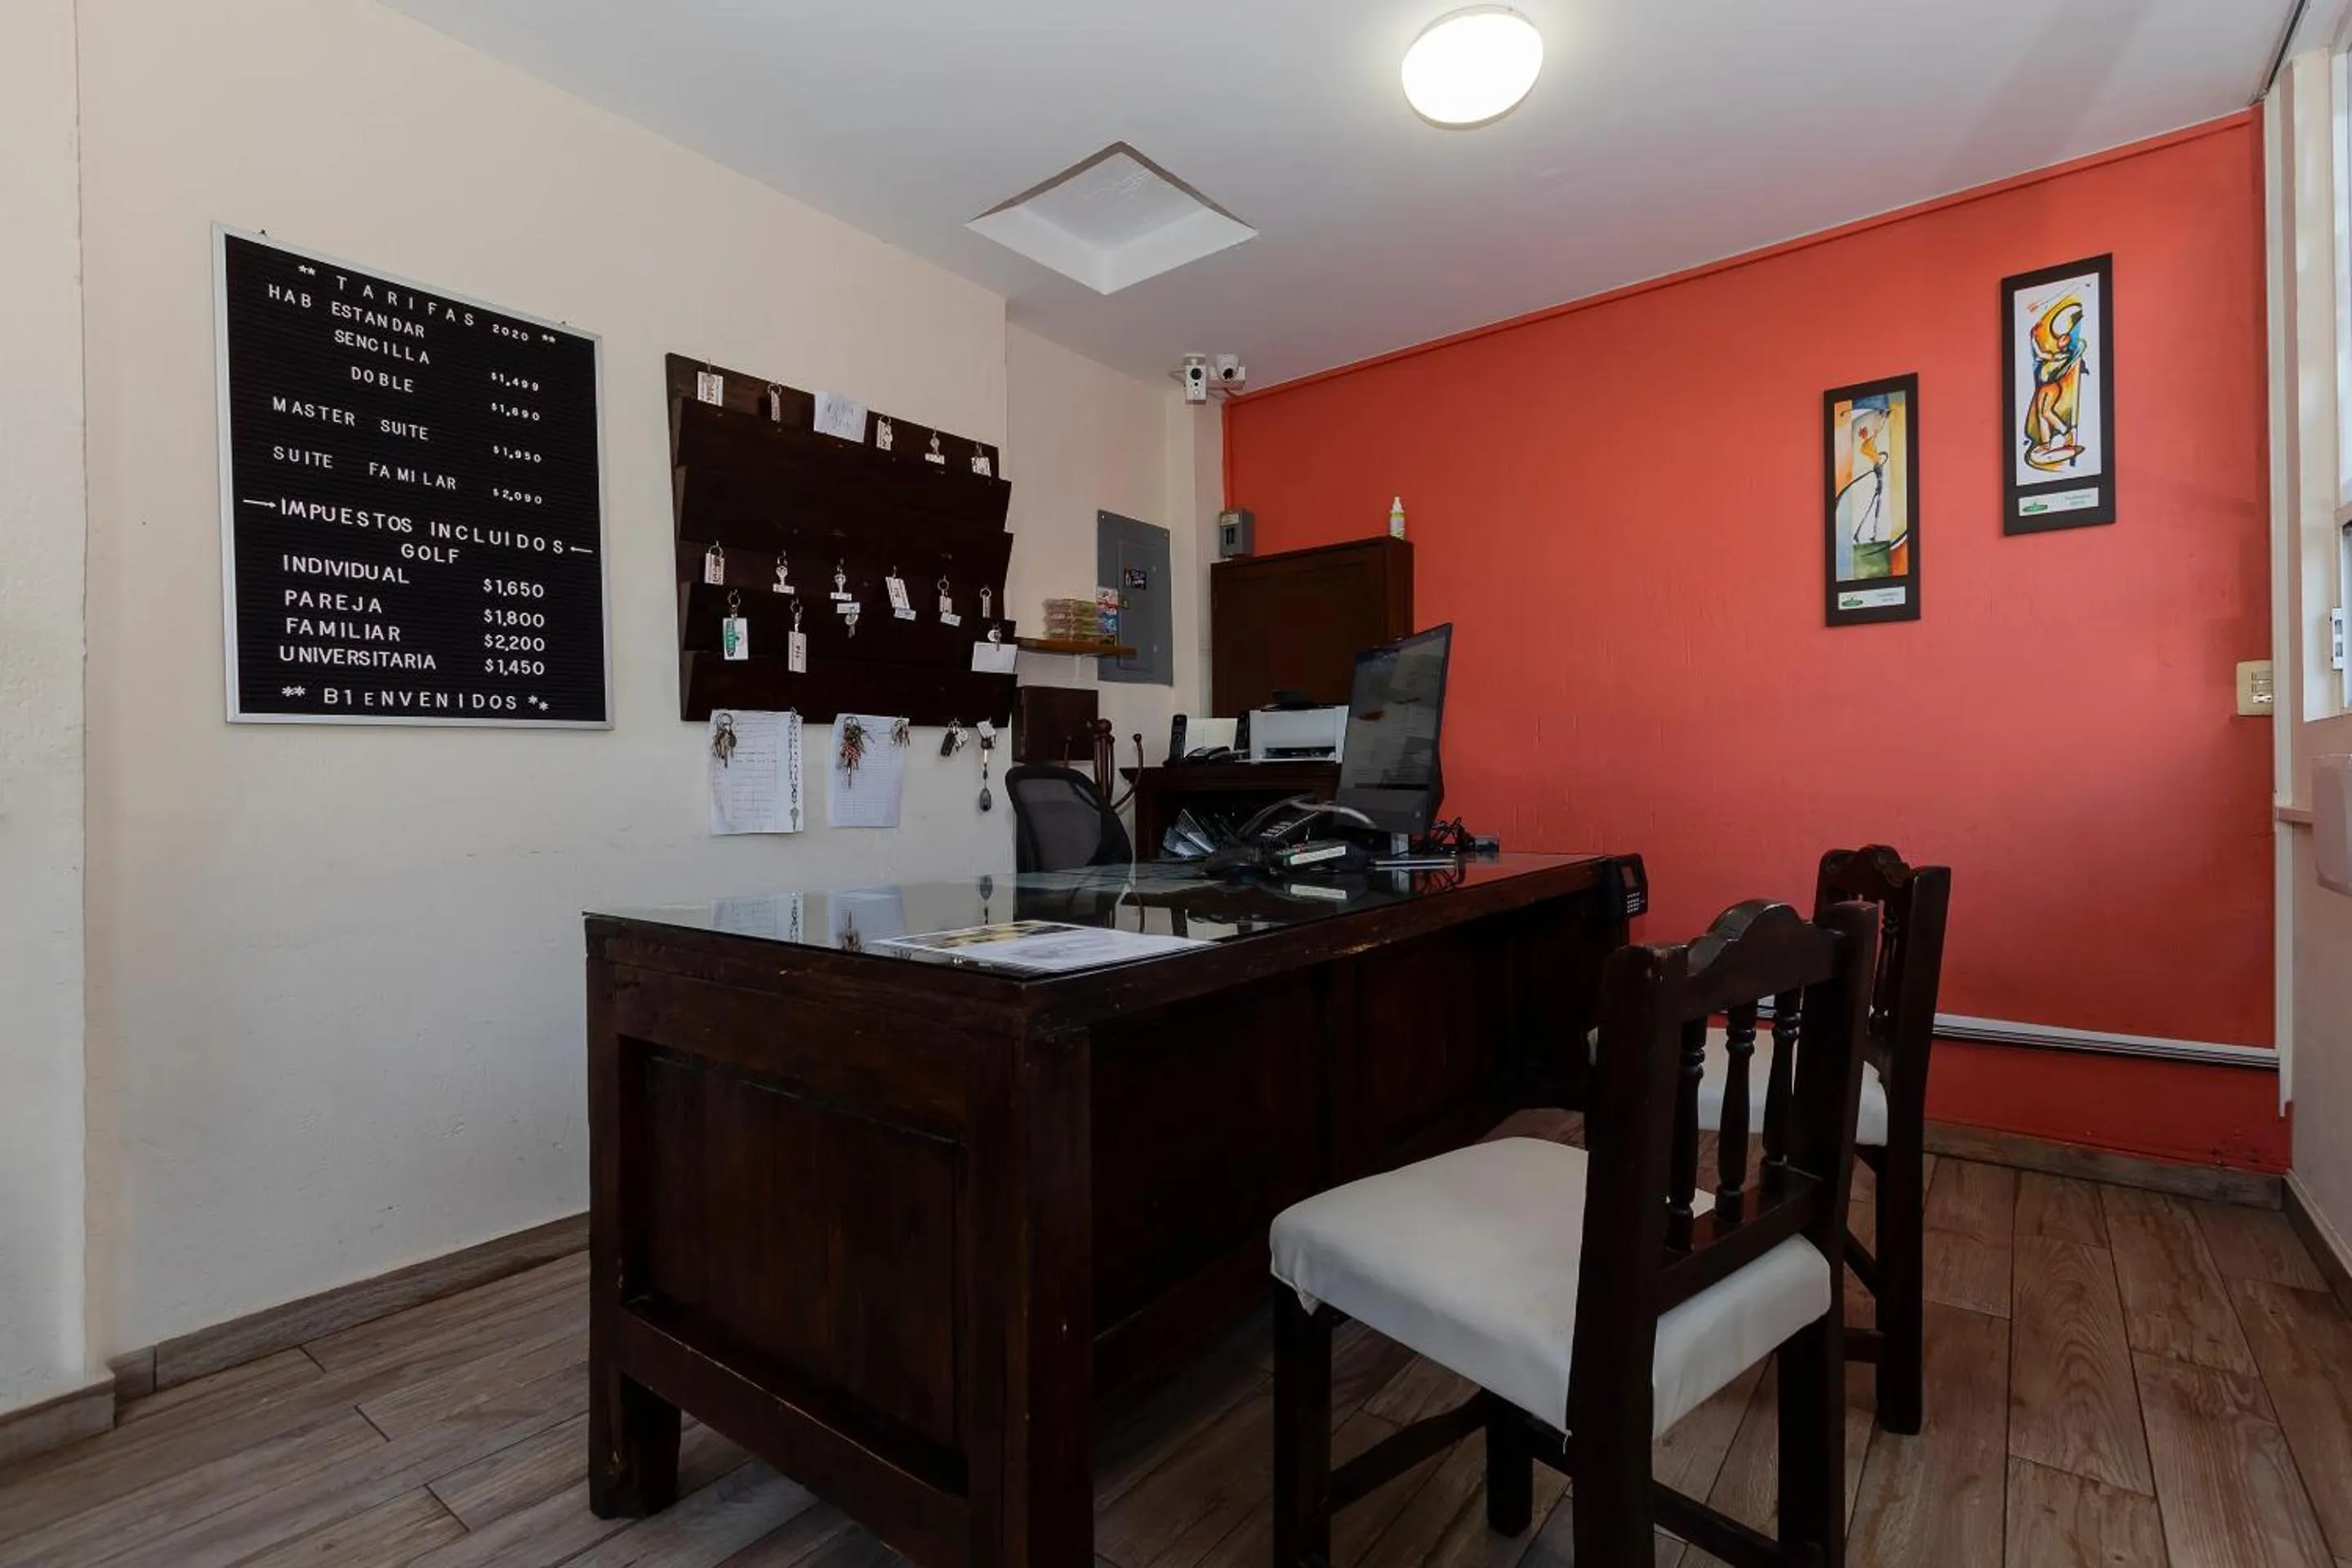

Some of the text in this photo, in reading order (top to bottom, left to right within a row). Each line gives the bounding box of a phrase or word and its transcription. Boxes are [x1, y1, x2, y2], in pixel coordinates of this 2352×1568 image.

[268, 283, 425, 339] HAB ESTANDAR
[336, 275, 529, 341] TARIFAS 2020
[334, 328, 430, 365] SENCILLA
[350, 366, 415, 394] DOBLE
[272, 395, 356, 427] MASTER
[380, 419, 430, 442] SUITE
[273, 445, 334, 470] SUITE
[368, 461, 457, 490] FAMILAR
[281, 497, 564, 555] IMPUESTOS INCLUIDOS
[283, 554, 410, 585] INDIVIDUAL
[400, 543, 461, 565] GOLF
[284, 589, 383, 614] PAREJA
[286, 617, 401, 643] FAMILIAR
[279, 645, 437, 671] UNIVERSITARIA
